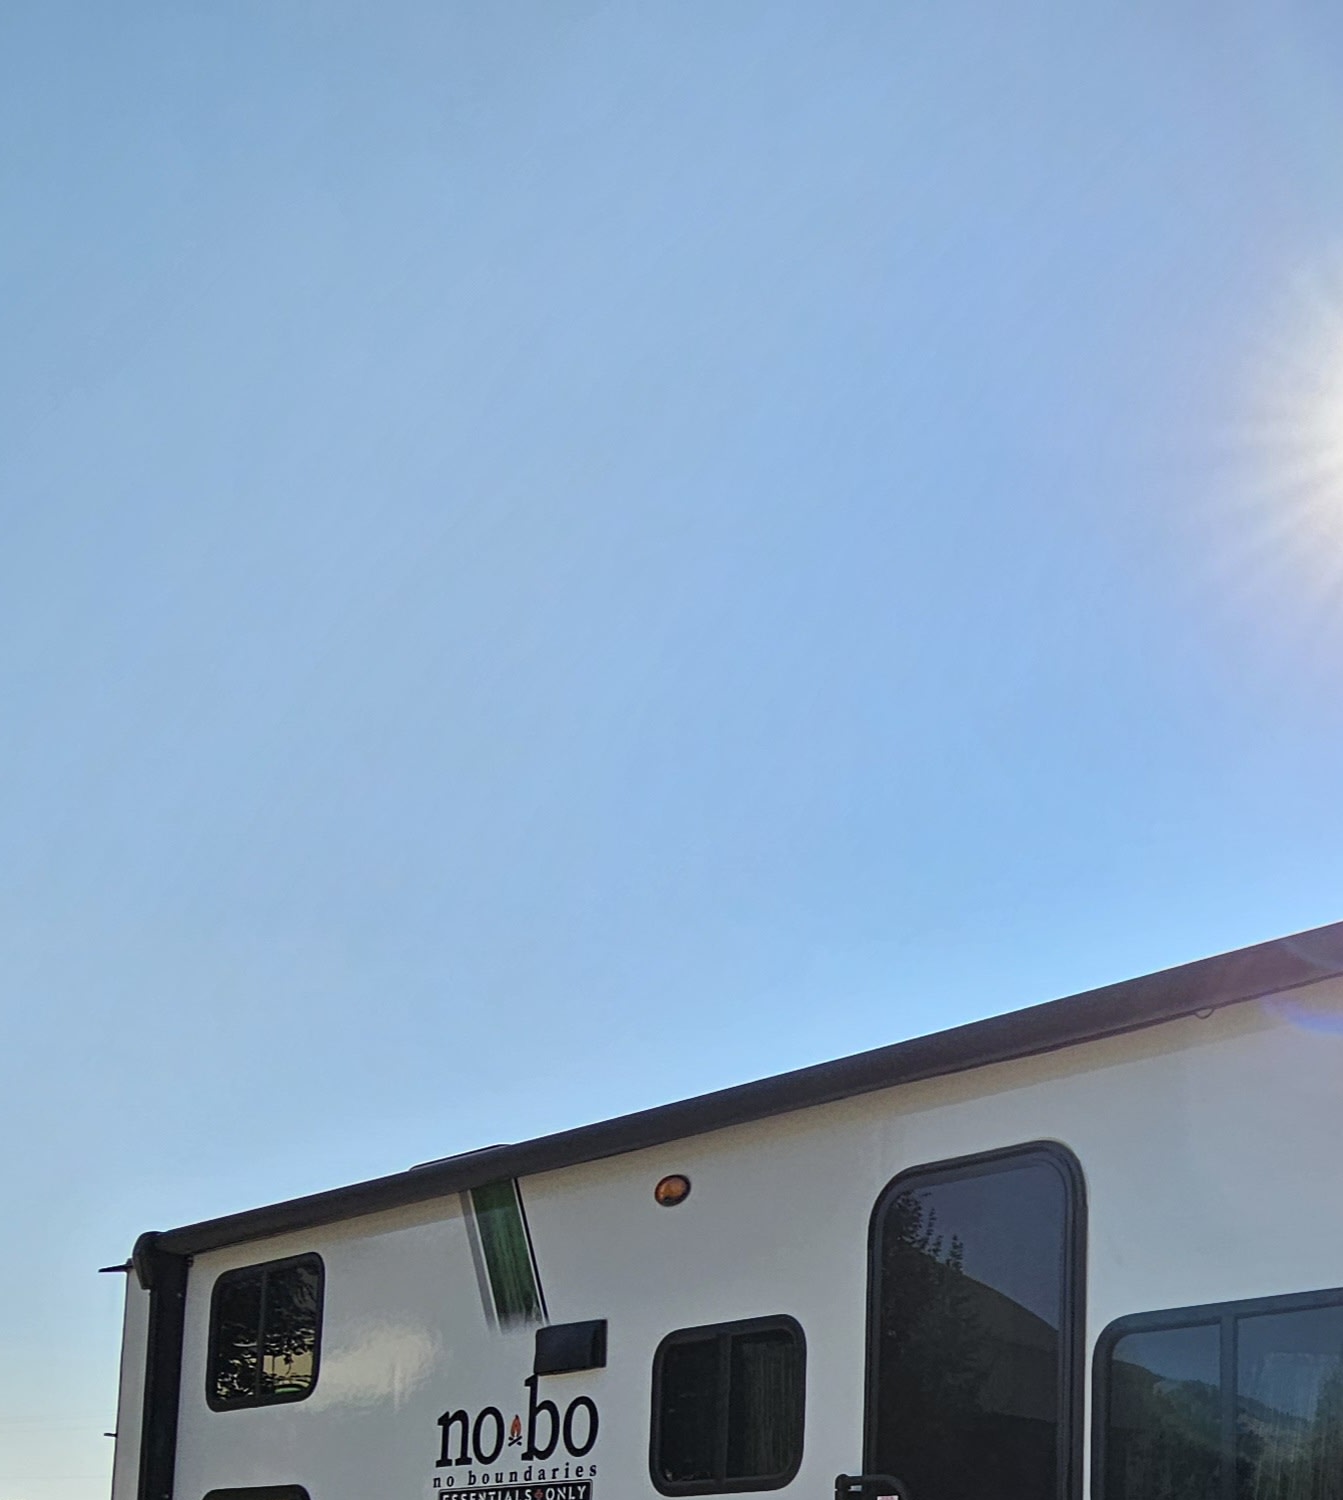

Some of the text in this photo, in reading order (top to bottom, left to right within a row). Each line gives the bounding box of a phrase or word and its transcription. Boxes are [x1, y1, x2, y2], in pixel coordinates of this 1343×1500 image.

[435, 1373, 600, 1468] no bo
[432, 1461, 597, 1488] no boundaries
